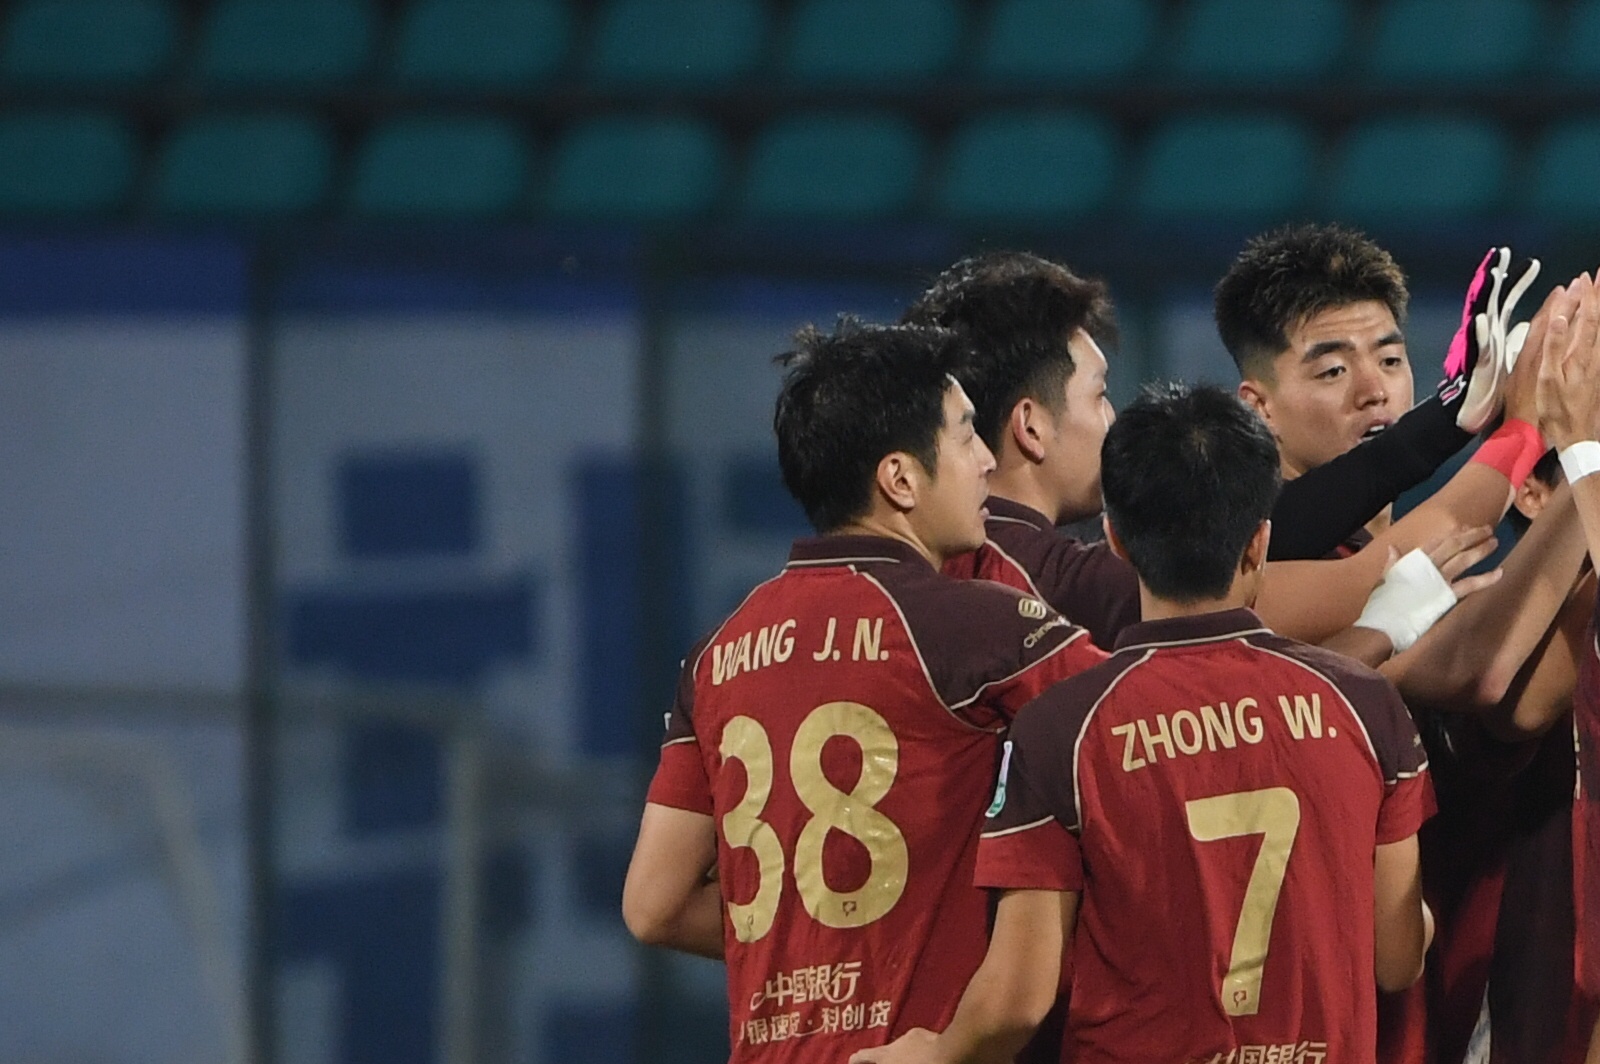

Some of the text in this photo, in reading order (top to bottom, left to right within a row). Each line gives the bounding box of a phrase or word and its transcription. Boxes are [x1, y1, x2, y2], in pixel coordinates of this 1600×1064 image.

[711, 617, 889, 685] WANG J. N.
[1111, 693, 1338, 772] ZHONG W.
[719, 701, 909, 943] 38
[1185, 786, 1301, 1017] 7
